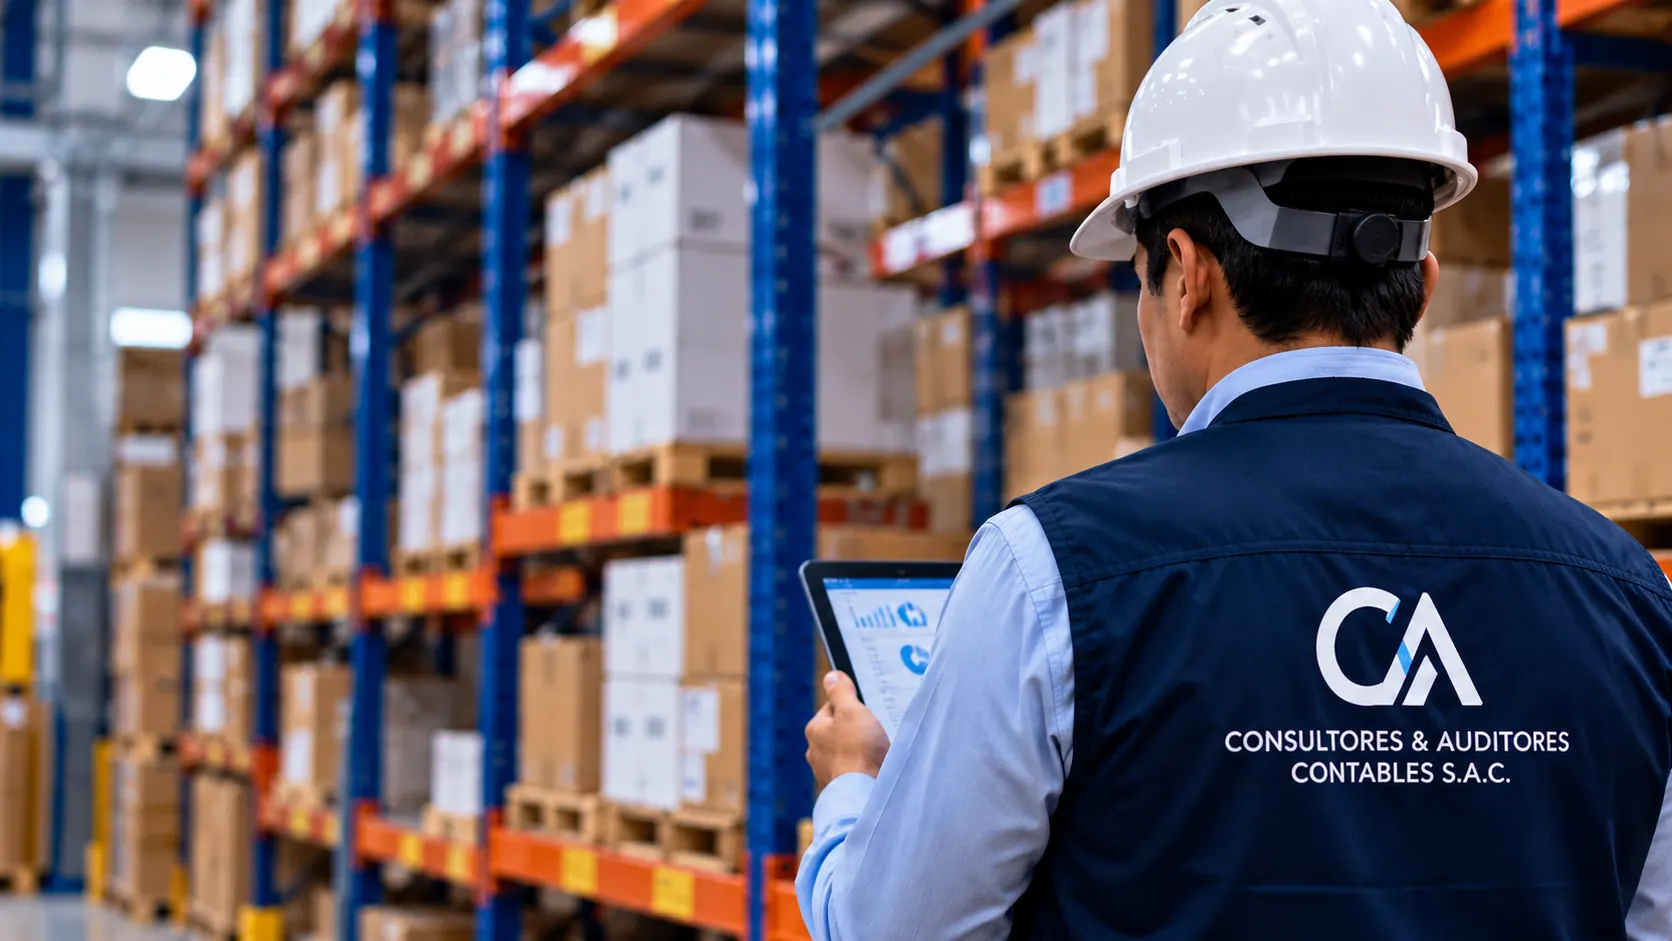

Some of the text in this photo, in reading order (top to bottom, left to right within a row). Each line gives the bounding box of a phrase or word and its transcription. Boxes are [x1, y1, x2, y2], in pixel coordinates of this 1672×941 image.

[1316, 587, 1483, 706] CA
[1224, 730, 1570, 752] CONSULTORES & AUDITORES
[1291, 762, 1511, 783] CONTABLES S.A.C.
